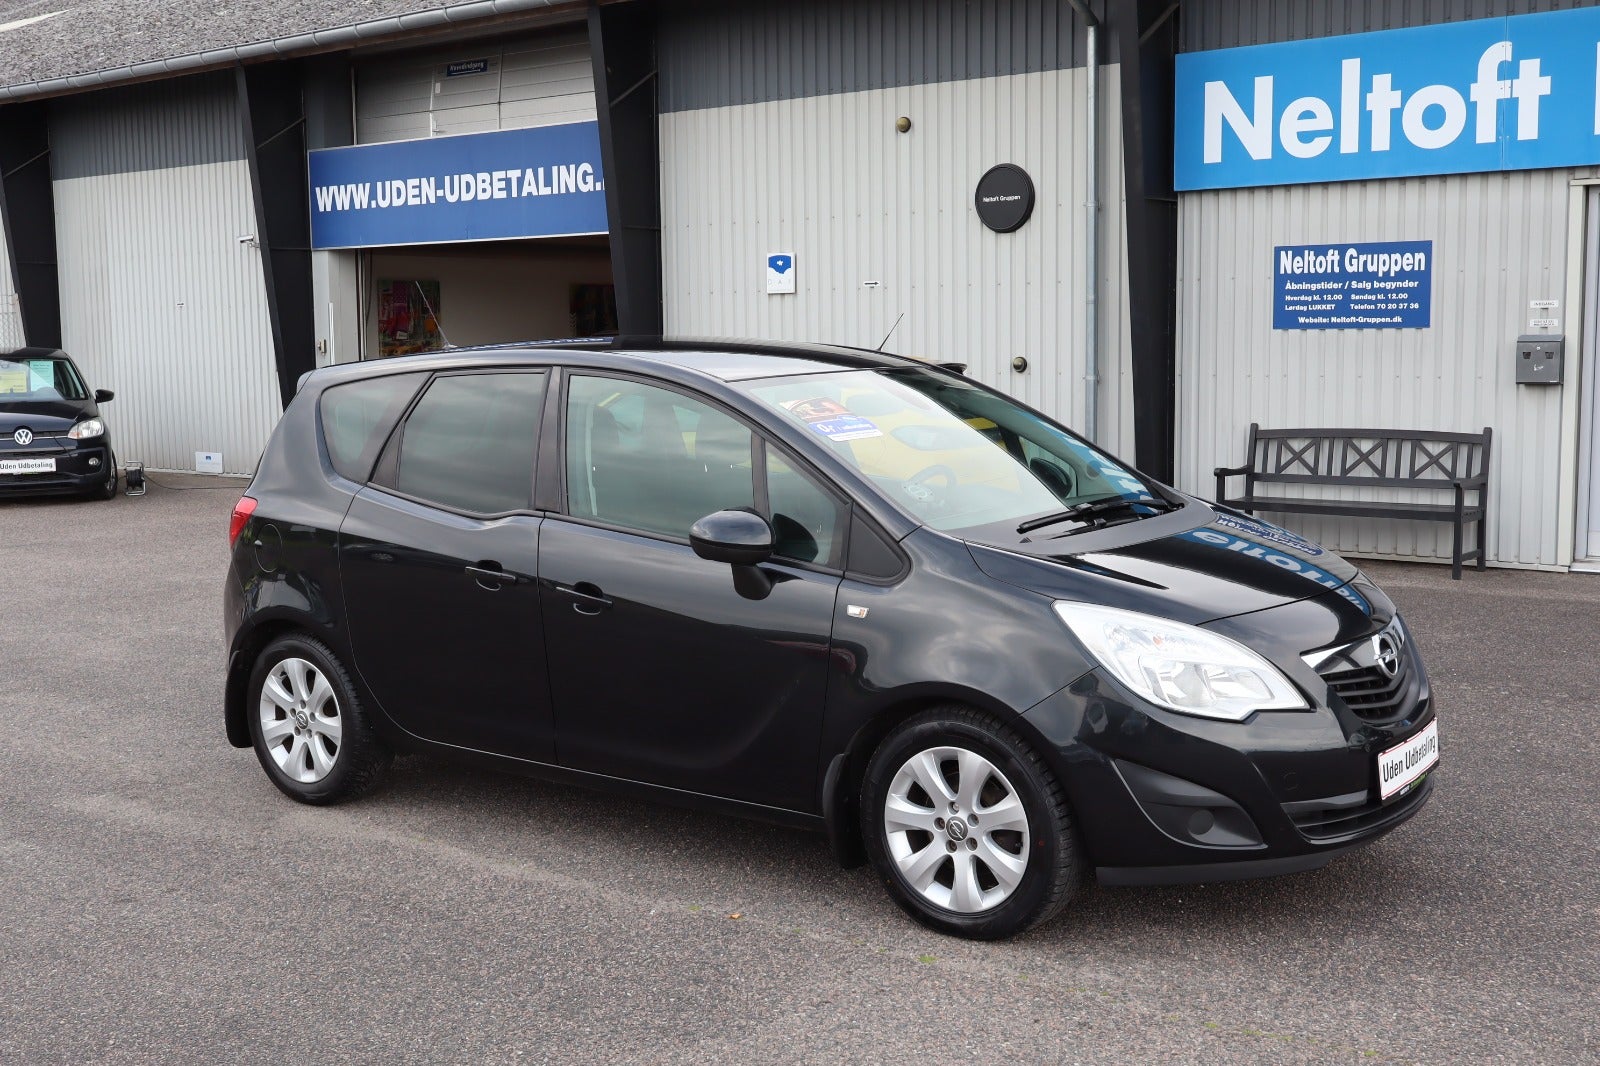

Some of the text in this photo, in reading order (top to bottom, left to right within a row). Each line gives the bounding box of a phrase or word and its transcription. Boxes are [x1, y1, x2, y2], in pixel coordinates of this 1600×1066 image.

[1203, 41, 1552, 164] Neltoft
[315, 162, 605, 212] WWW.UDEN-UDBETALING.
[1280, 248, 1426, 277] Neltoft Gruppen
[1285, 280, 1343, 290] Åbningstider
[1351, 281, 1371, 290] Salg
[1373, 280, 1419, 290] begynder
[1298, 316, 1402, 325] Website: Neltoft-Gruppen.dk
[1382, 735, 1436, 782] Uden Udbetaling
